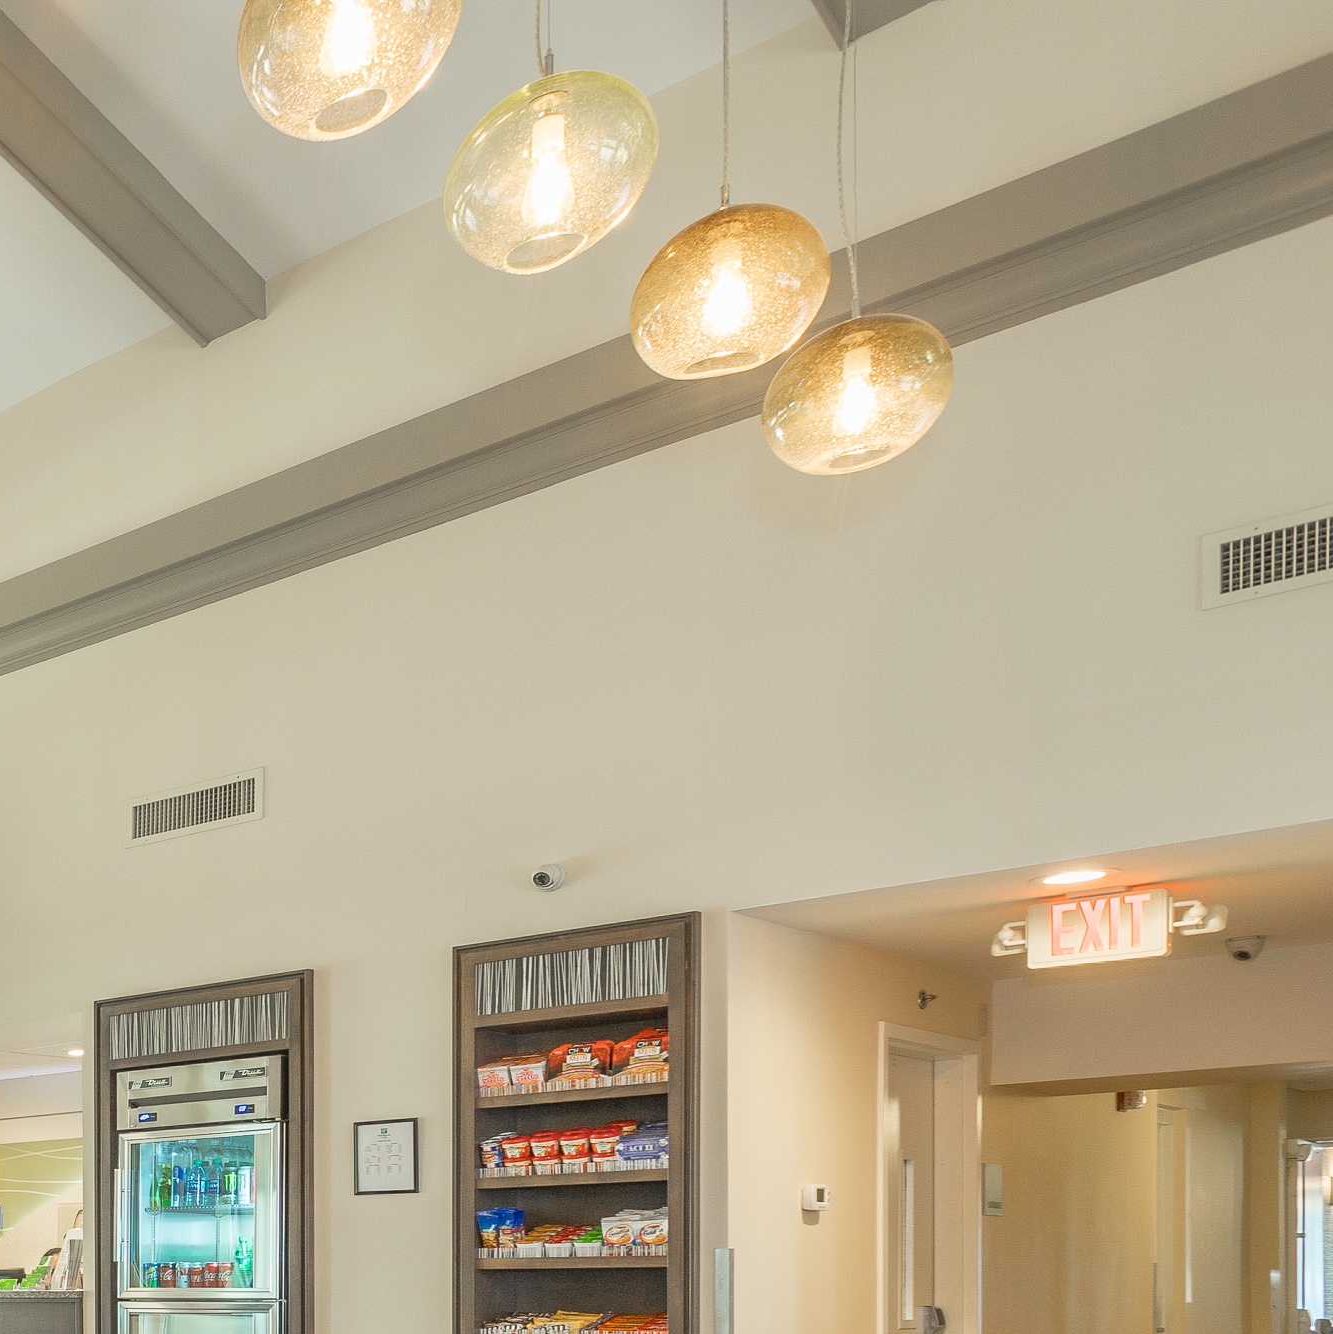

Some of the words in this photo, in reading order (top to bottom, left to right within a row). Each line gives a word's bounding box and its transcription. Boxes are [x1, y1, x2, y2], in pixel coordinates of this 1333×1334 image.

[1051, 893, 1151, 956] EXIT
[636, 1039, 661, 1048] CHW
[568, 1047, 591, 1055] CHW
